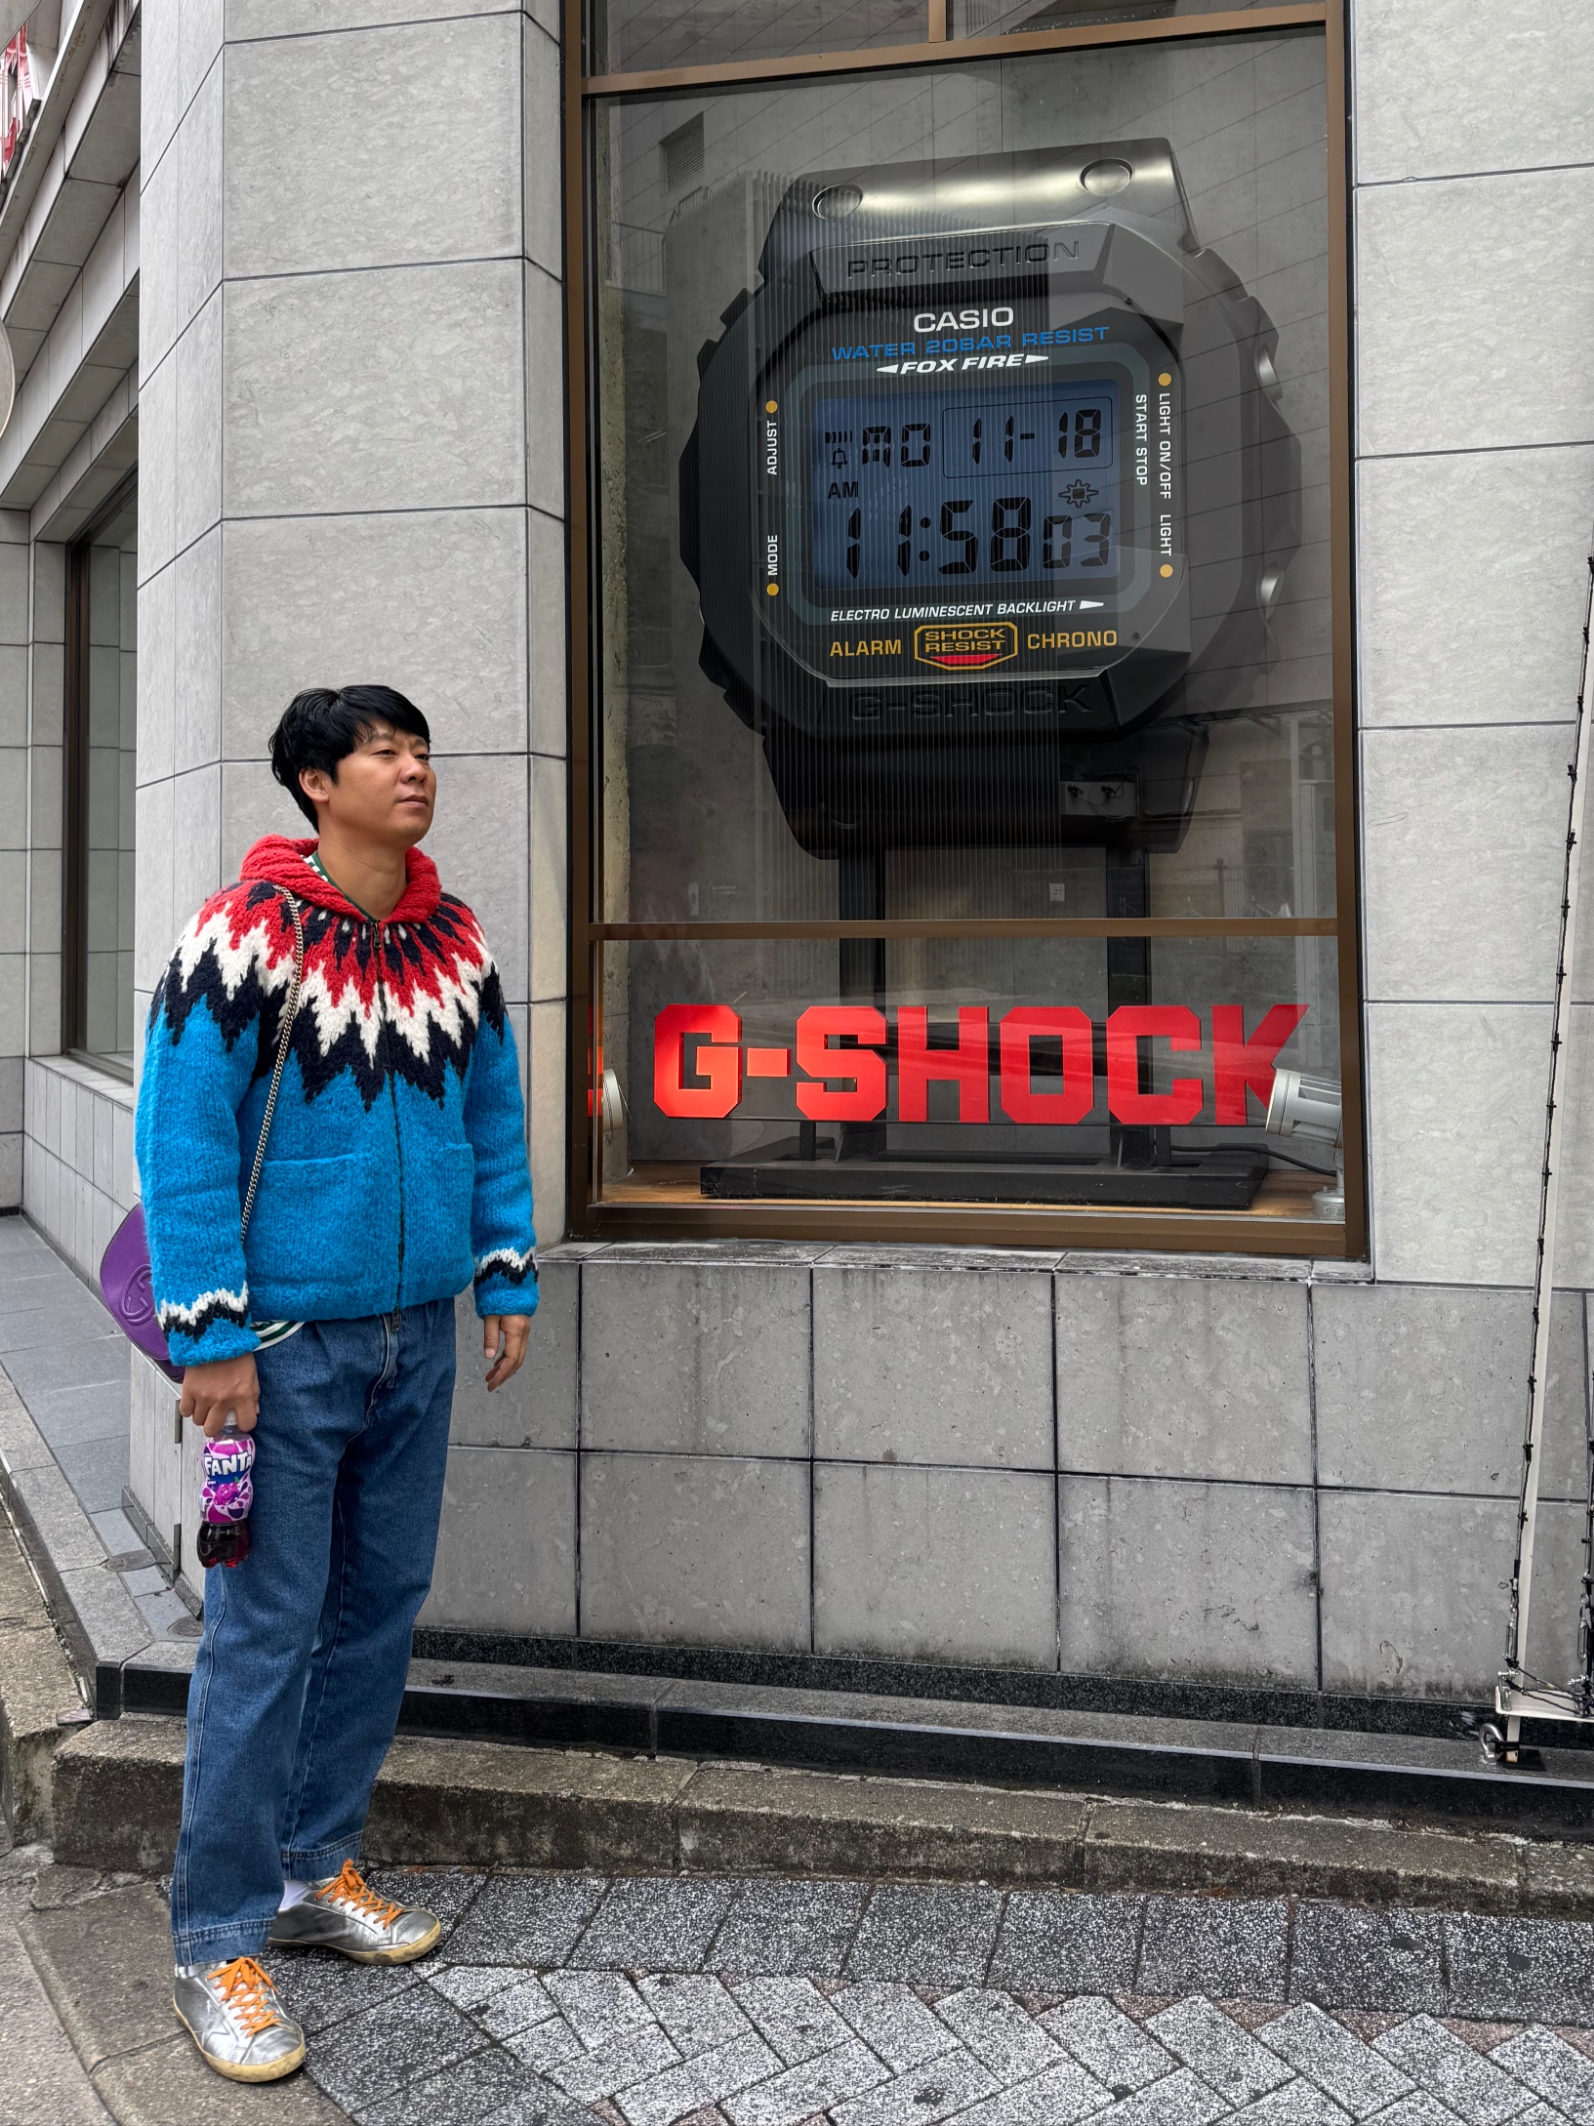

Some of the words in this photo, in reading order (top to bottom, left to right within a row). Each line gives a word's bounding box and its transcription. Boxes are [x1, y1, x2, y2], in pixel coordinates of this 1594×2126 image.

[848, 240, 1080, 279] PROTECTION
[913, 306, 1014, 334] CASIO
[831, 341, 916, 361] WATER
[925, 334, 1012, 355] 20BAR
[1022, 326, 1110, 348] RESIST
[900, 358, 957, 375] FOX
[961, 353, 1025, 370] FIRE
[1135, 393, 1147, 444] START
[1159, 392, 1171, 436] LIGHT
[766, 419, 778, 476] ADJUST
[1136, 446, 1148, 486] STOP
[1159, 438, 1172, 500] ON/OFF
[827, 480, 860, 500] AM
[1160, 514, 1172, 557] LIGHT
[767, 533, 778, 577] MODE
[830, 607, 890, 622] ELECTRO
[894, 603, 994, 620] LUMINESCENT
[996, 600, 1076, 616] BACKLIGHT
[829, 638, 902, 658] ALARM
[924, 627, 1006, 642] SHOCK
[924, 639, 1006, 653] RESIST
[1026, 629, 1118, 650] CHRONO
[851, 684, 1094, 721] G-SHOCK
[653, 1003, 1310, 1126] G-SHOCK
[204, 1452, 252, 1477] FANTA
